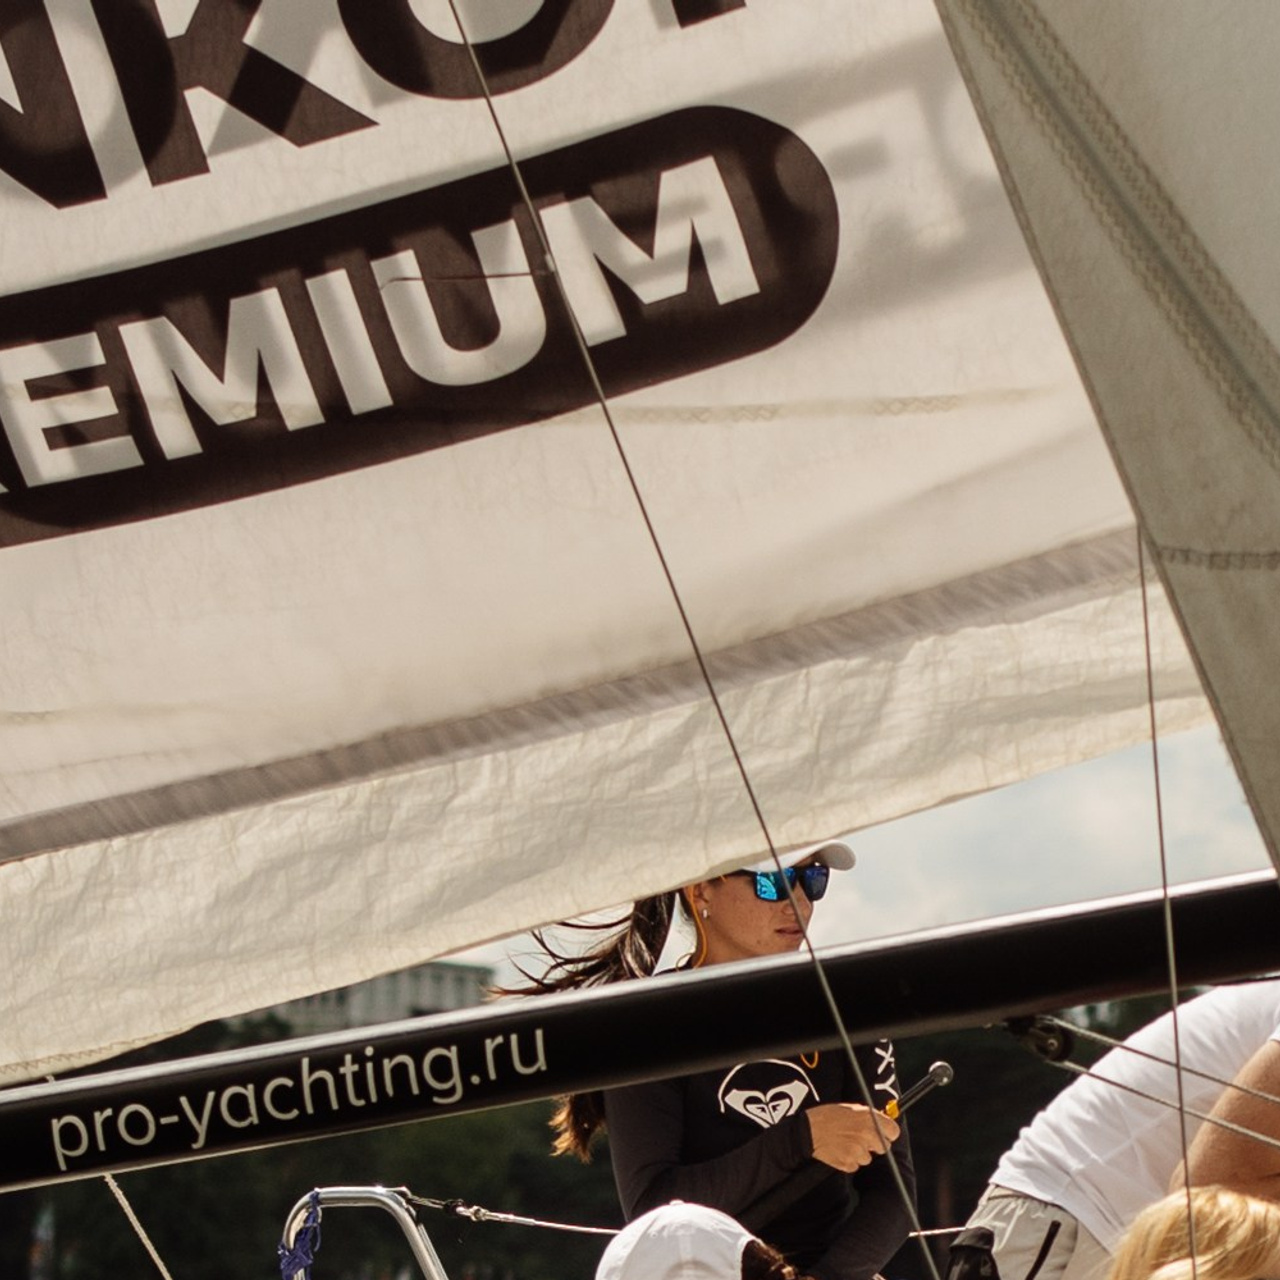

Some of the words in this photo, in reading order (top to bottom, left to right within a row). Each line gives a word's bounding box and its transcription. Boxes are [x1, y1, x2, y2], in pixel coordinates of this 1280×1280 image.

[0, 156, 760, 493] EMIUM
[51, 1028, 547, 1170] pro-yachting.ru
[874, 1038, 899, 1100] XY
